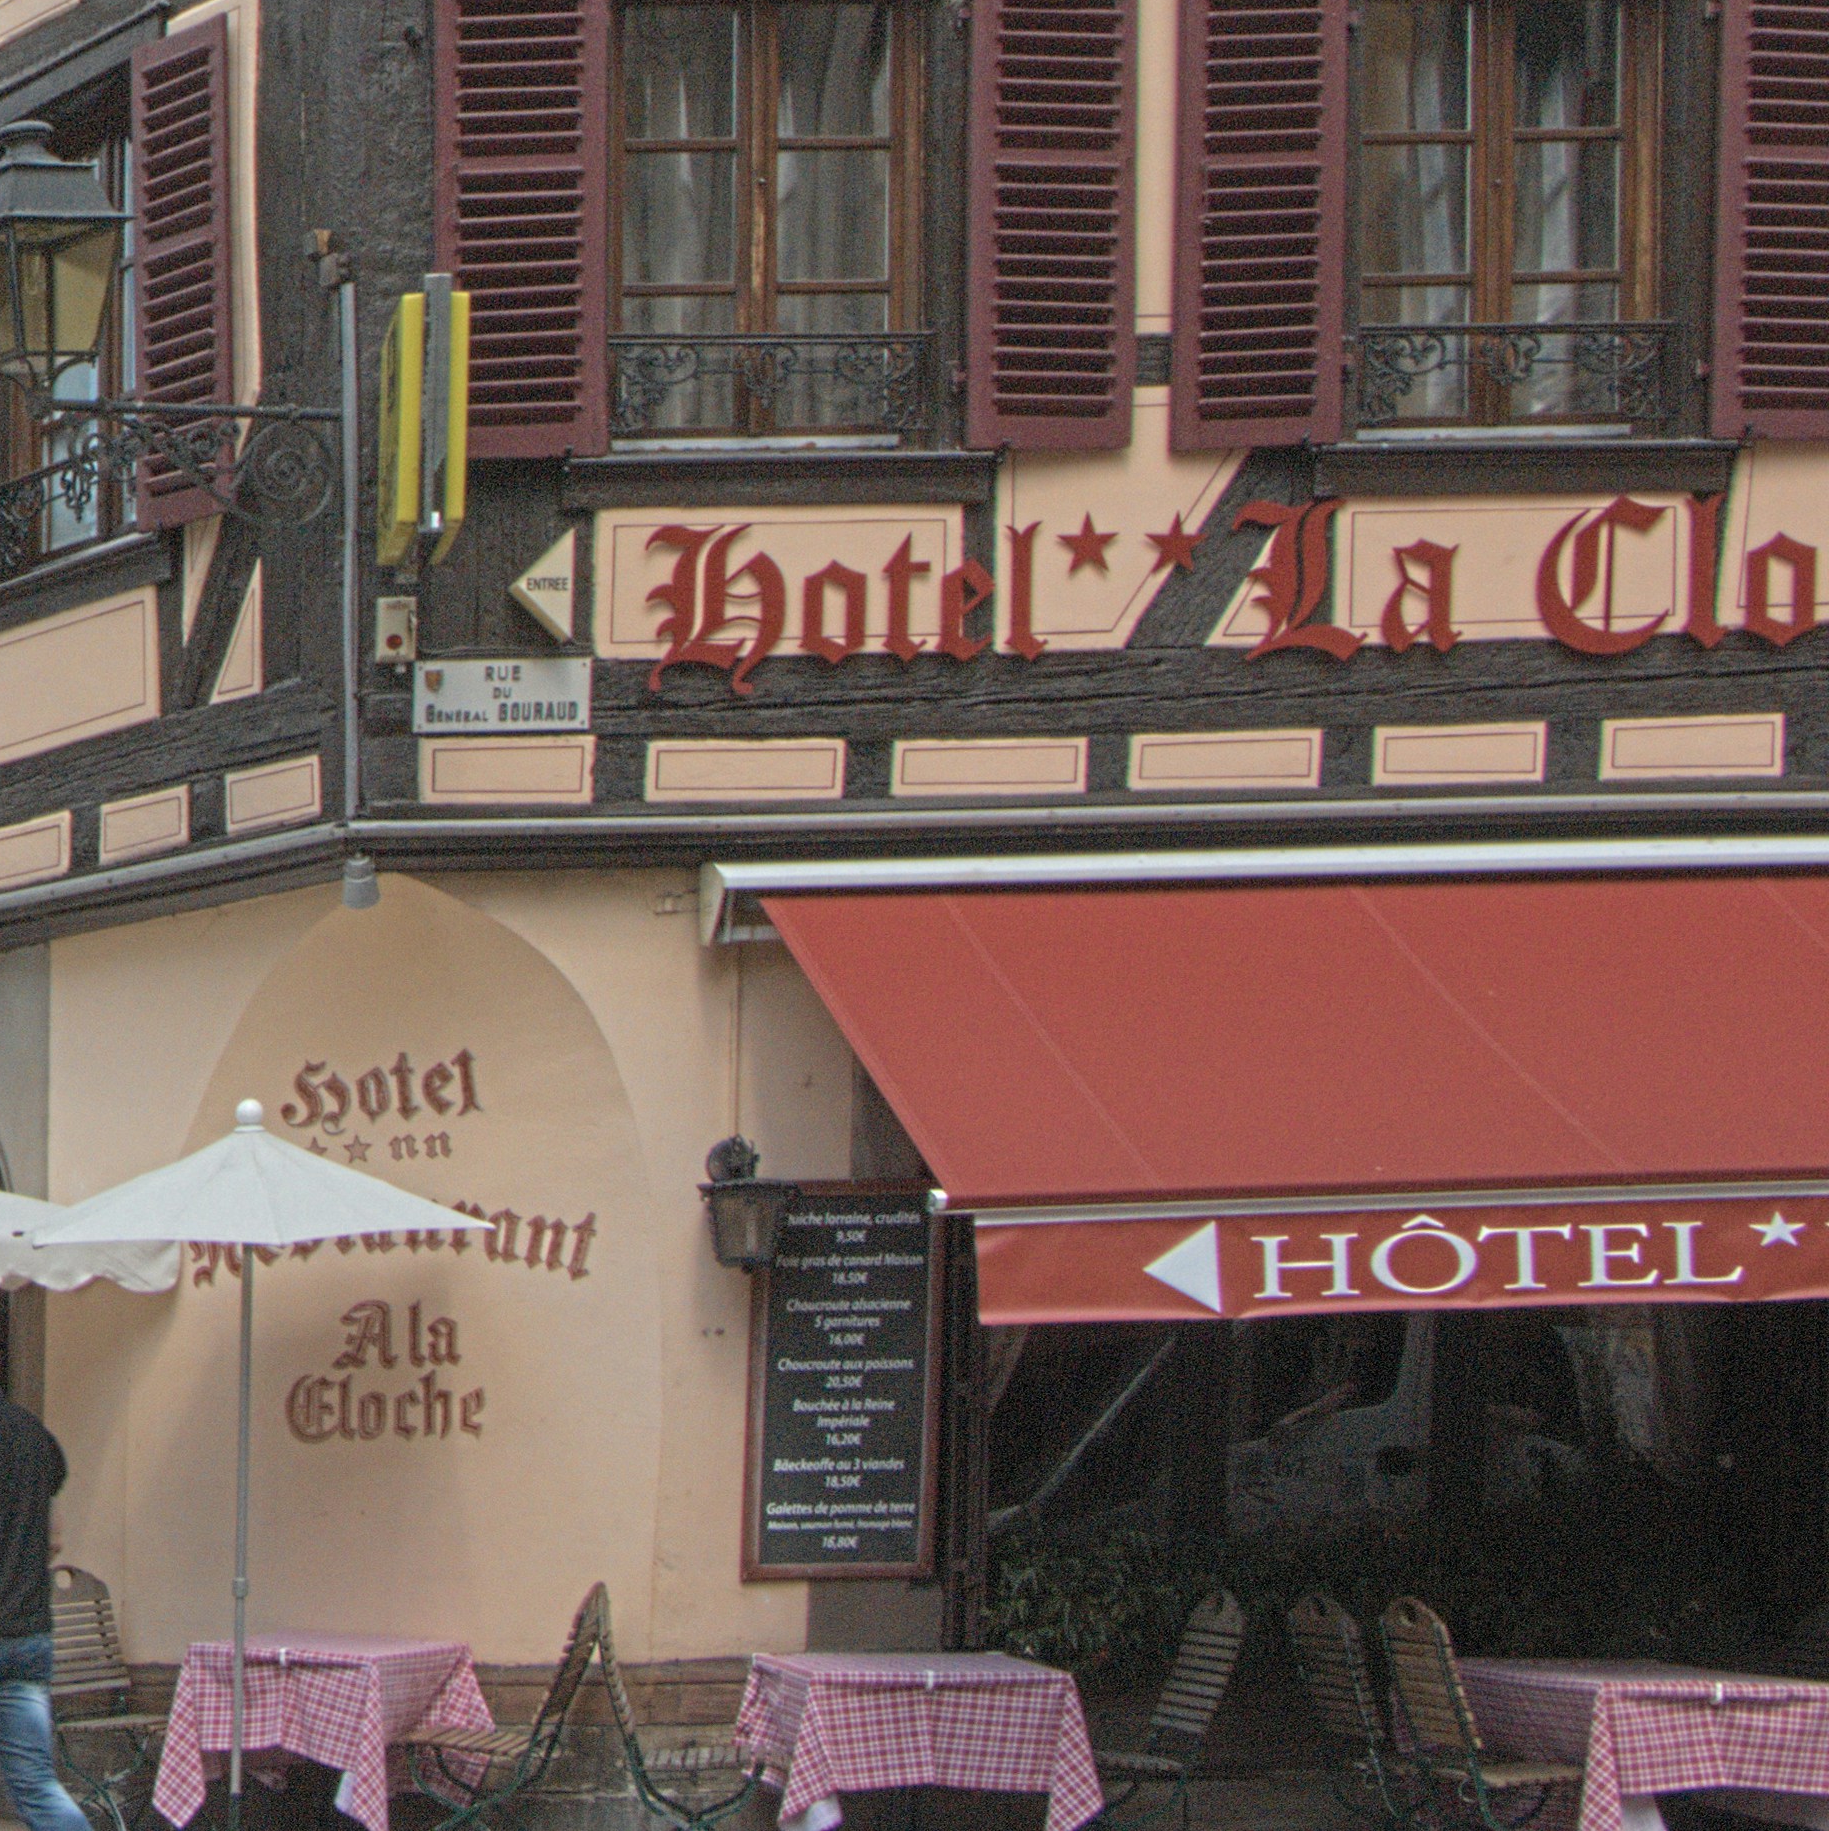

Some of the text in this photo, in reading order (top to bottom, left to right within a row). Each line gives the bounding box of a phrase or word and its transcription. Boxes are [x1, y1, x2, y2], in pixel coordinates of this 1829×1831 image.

[526, 577, 569, 591] ENTREE
[1232, 498, 1464, 662] La
[644, 519, 1048, 694] Hotel
[484, 665, 522, 681] RUE
[493, 687, 512, 699] DU
[498, 700, 579, 721] GOURAUD
[281, 1048, 484, 1136] Hotel
[788, 1212, 822, 1226] uiche
[1250, 1213, 1744, 1299] HÔTEL
